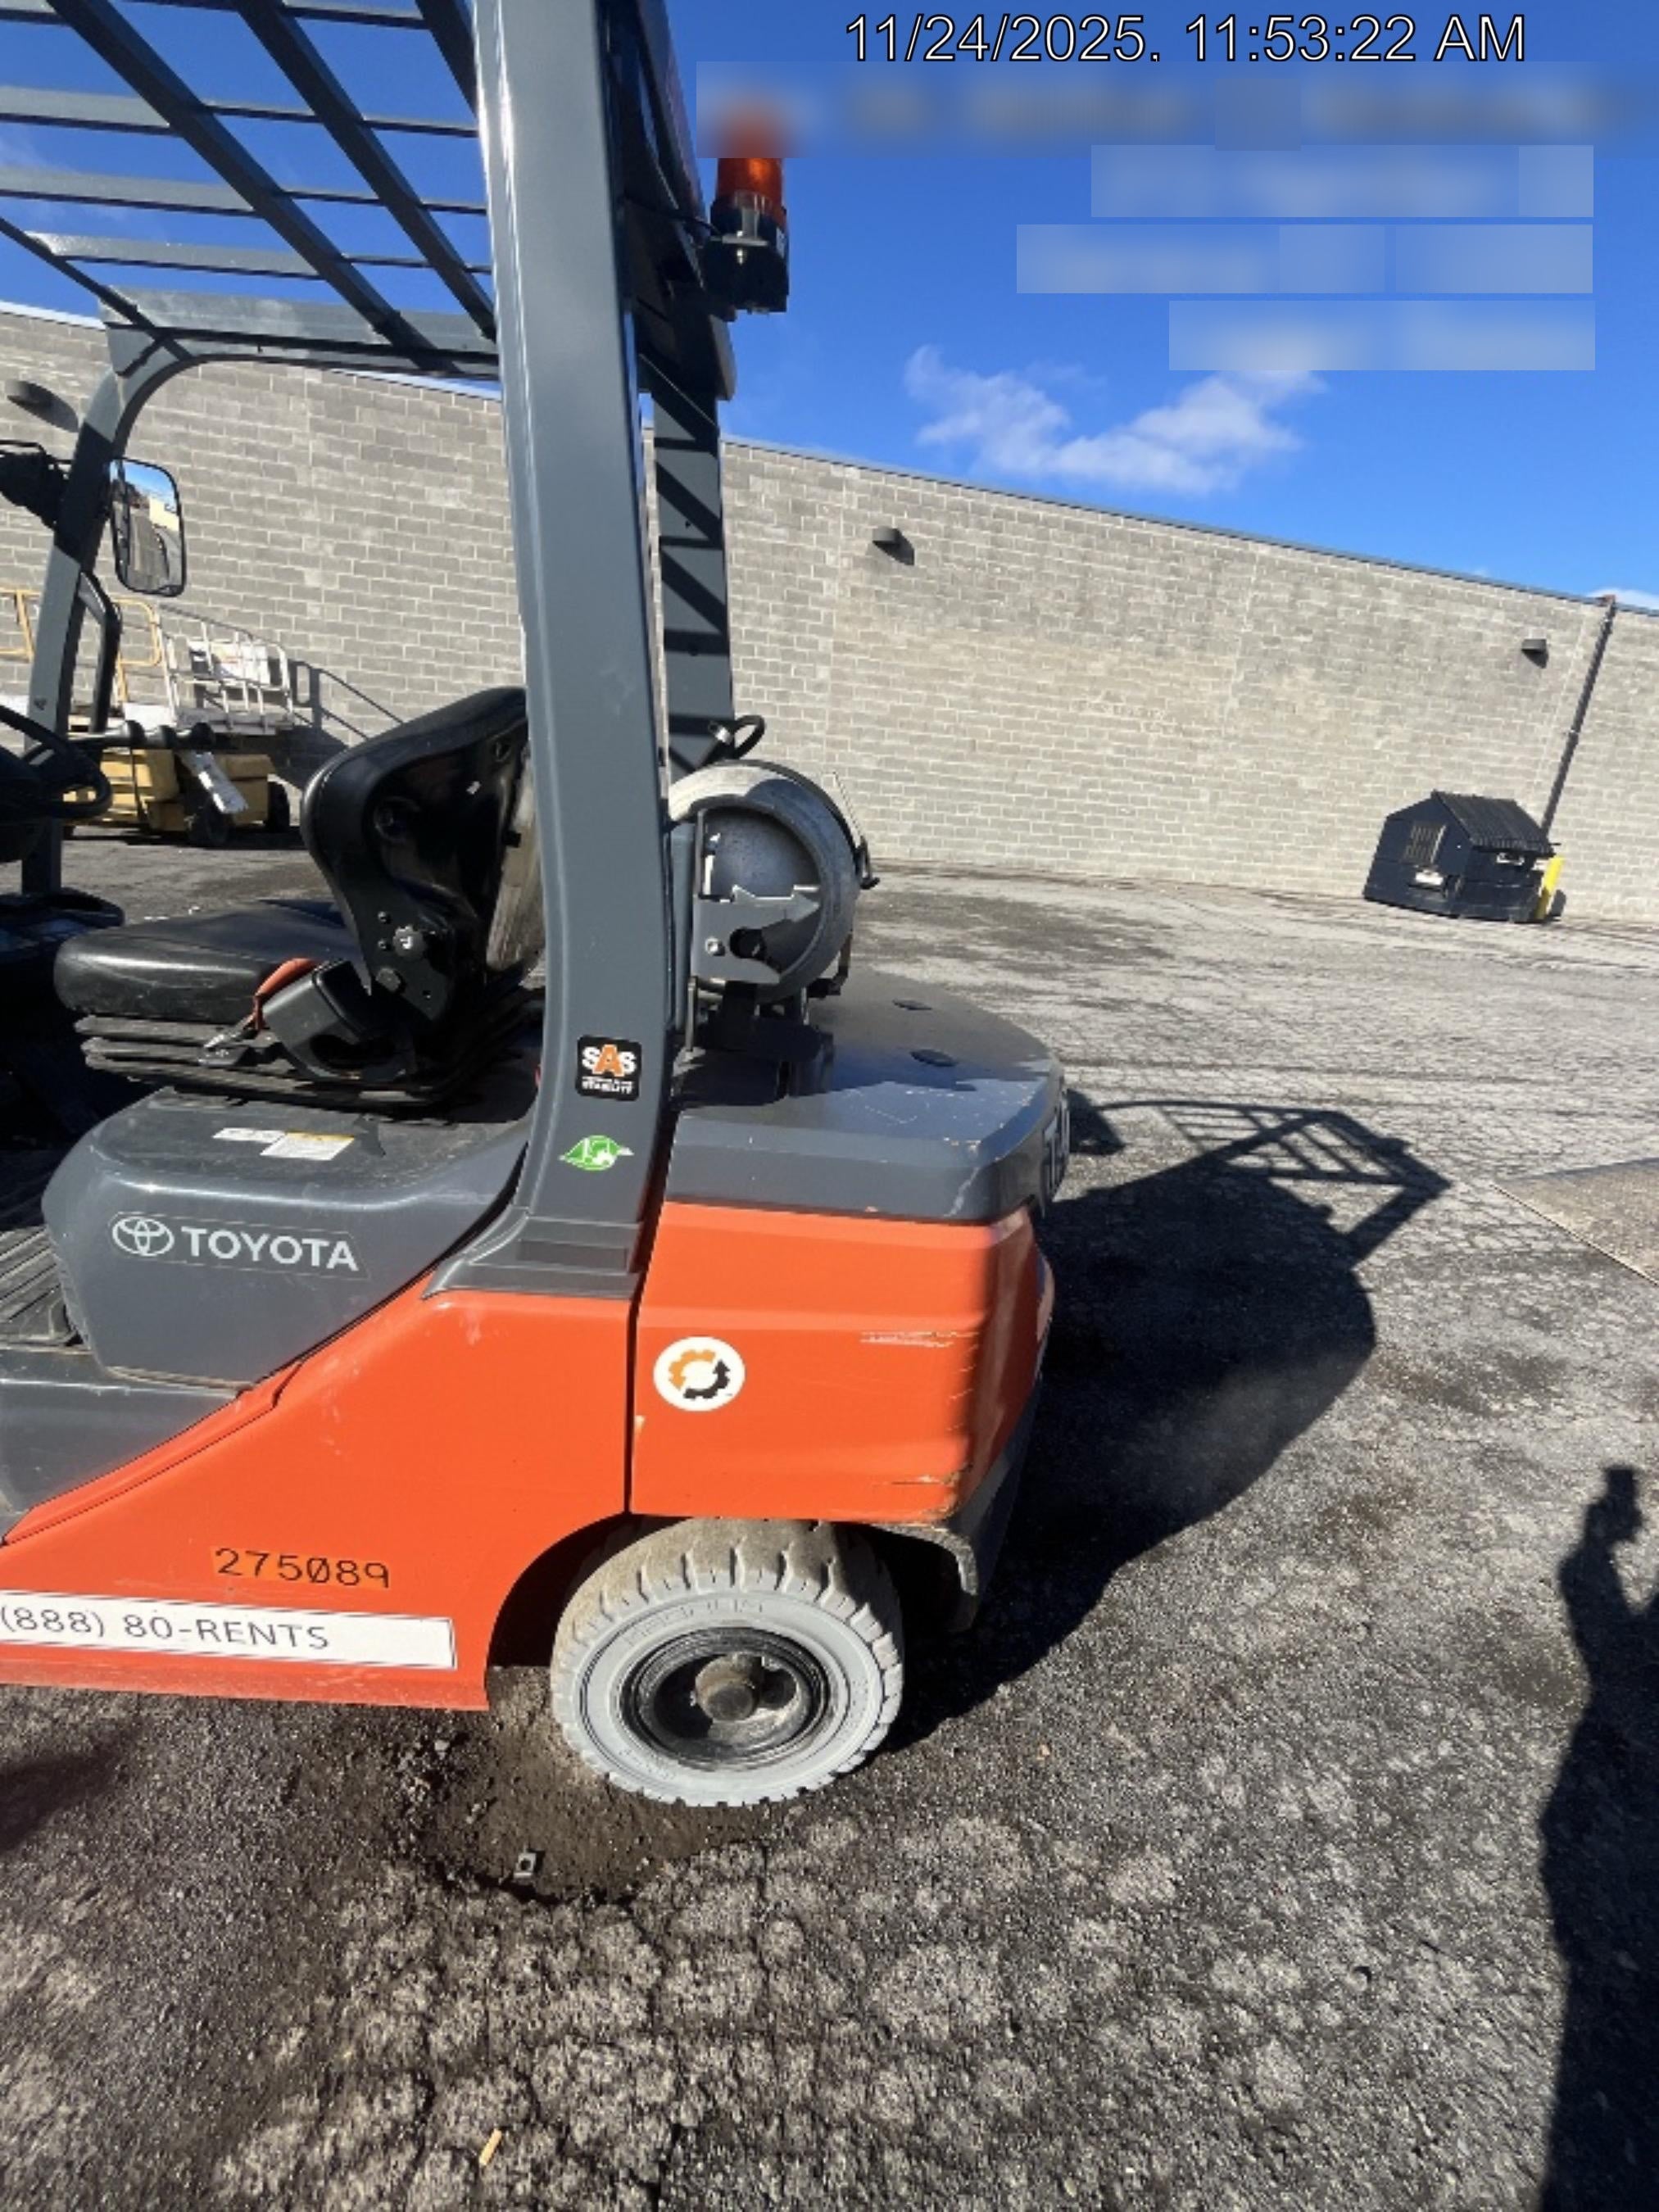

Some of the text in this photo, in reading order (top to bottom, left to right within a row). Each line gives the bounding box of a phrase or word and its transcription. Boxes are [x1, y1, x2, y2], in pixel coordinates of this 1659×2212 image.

[582, 1044, 637, 1077] SAS
[181, 1226, 359, 1271] TOYOTA
[215, 1547, 389, 1589] 275089
[1, 1606, 329, 1649] (888) 80-RENTS
